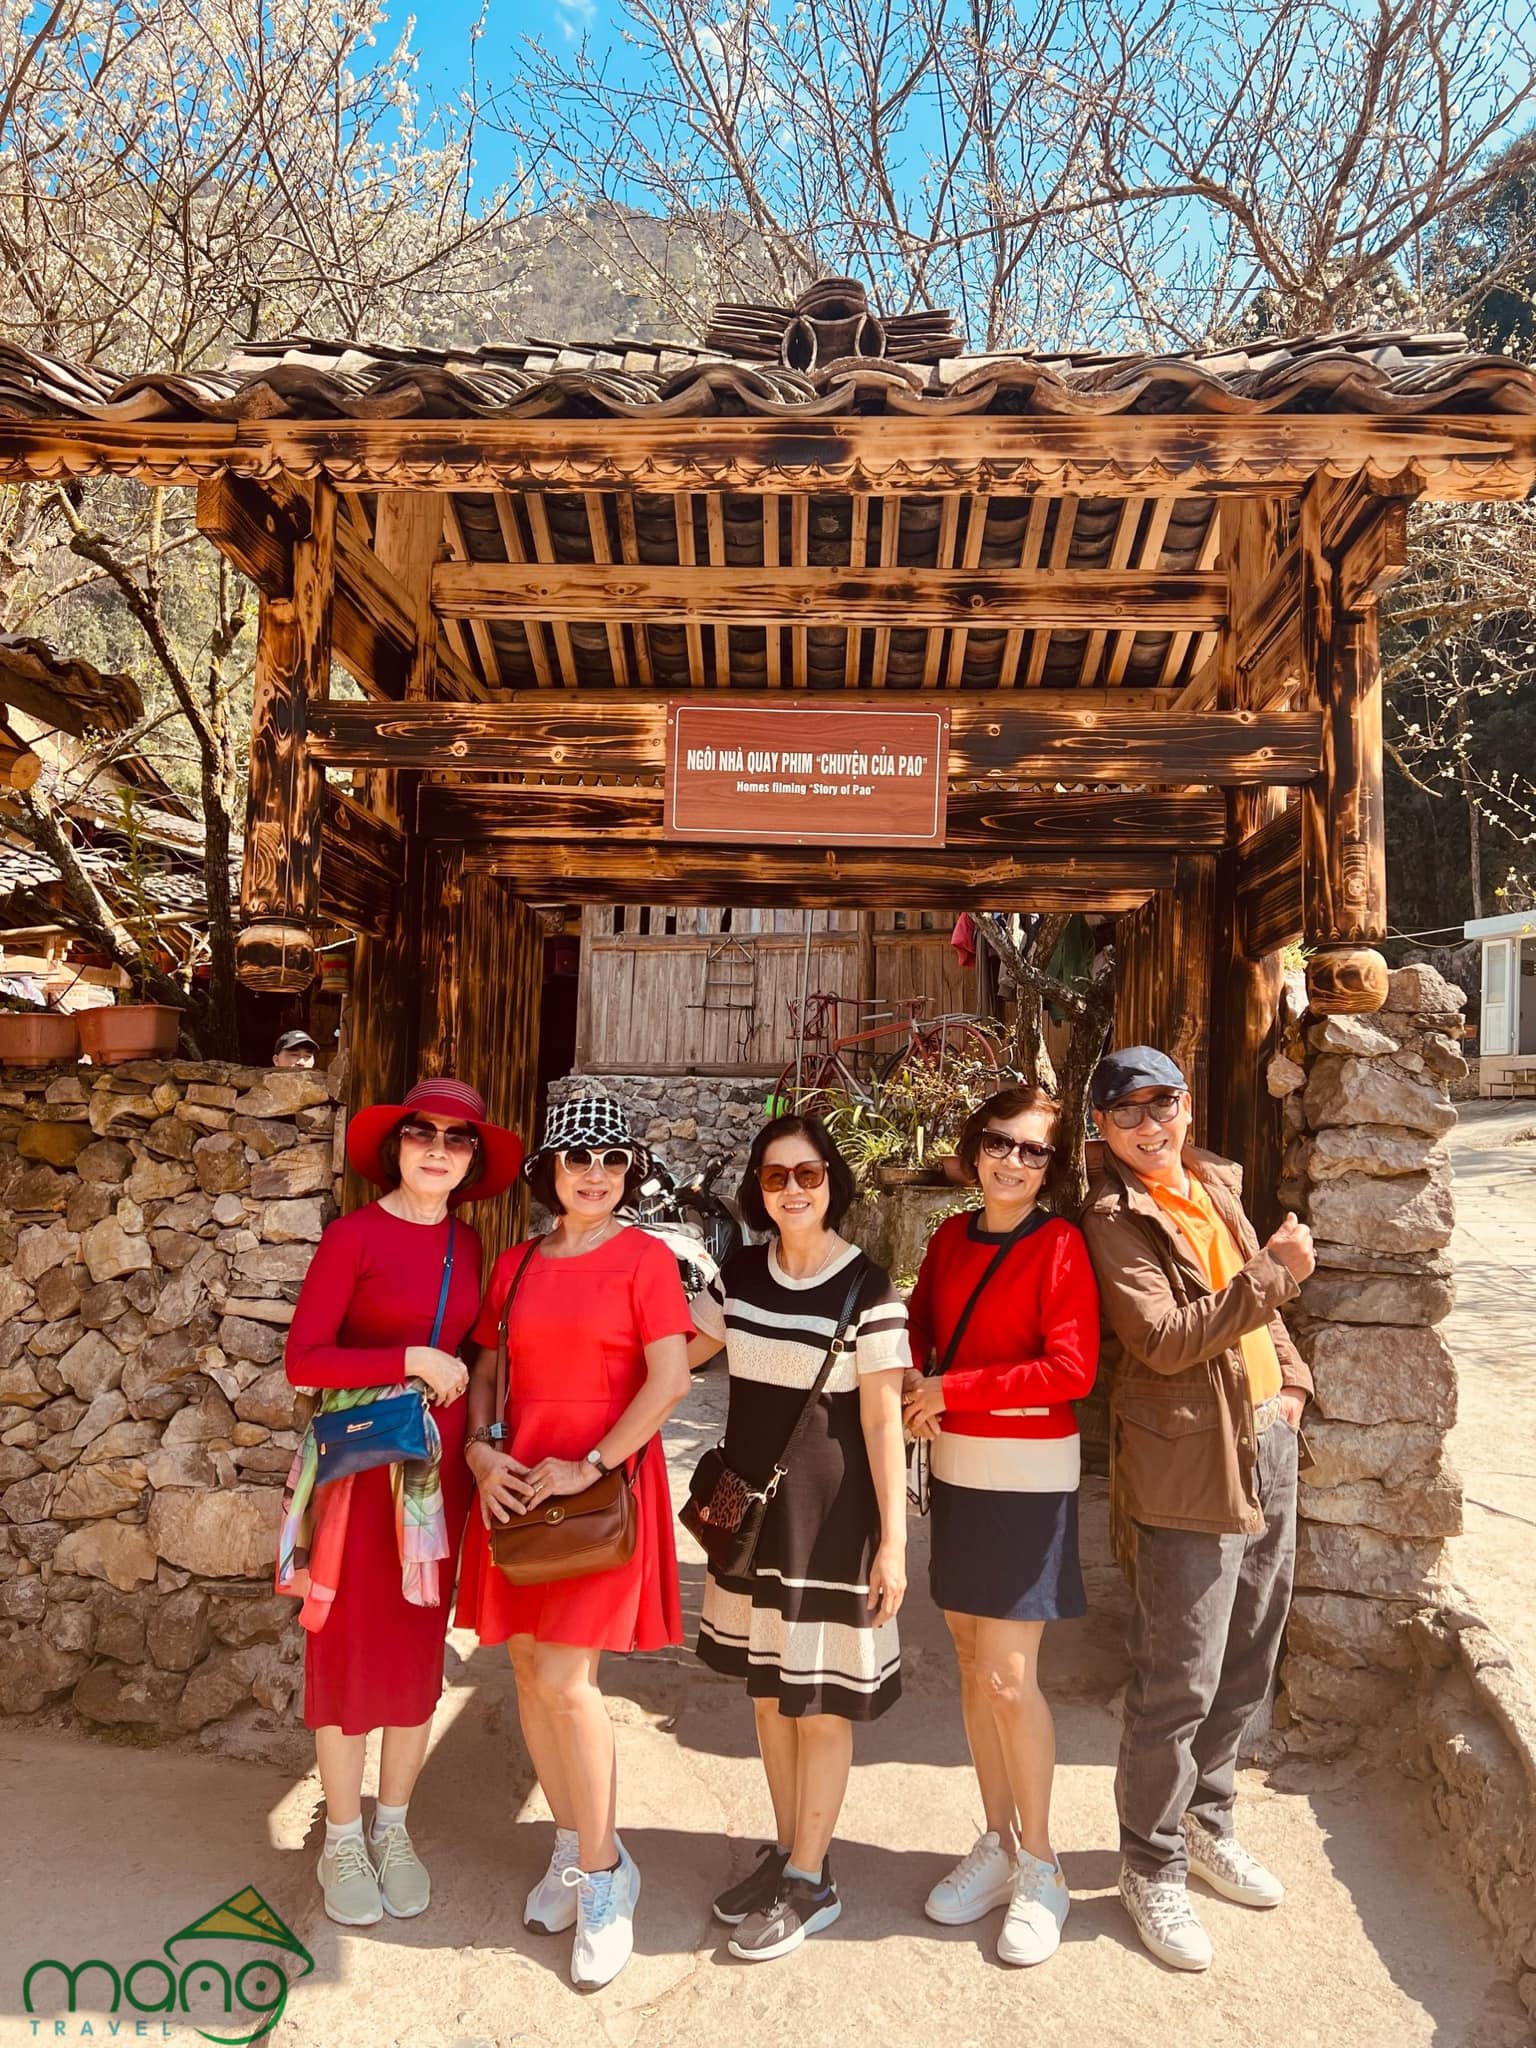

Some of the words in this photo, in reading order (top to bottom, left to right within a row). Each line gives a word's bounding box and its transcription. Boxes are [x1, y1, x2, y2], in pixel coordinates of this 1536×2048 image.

[687, 745, 716, 771] NGÔI
[719, 746, 744, 772] NHÀ
[747, 751, 778, 775] QUAY
[781, 752, 813, 774] PHIM
[871, 746, 895, 776] CỦA
[736, 781, 770, 793] Homes
[772, 782, 806, 795] filming
[840, 784, 850, 795] of
